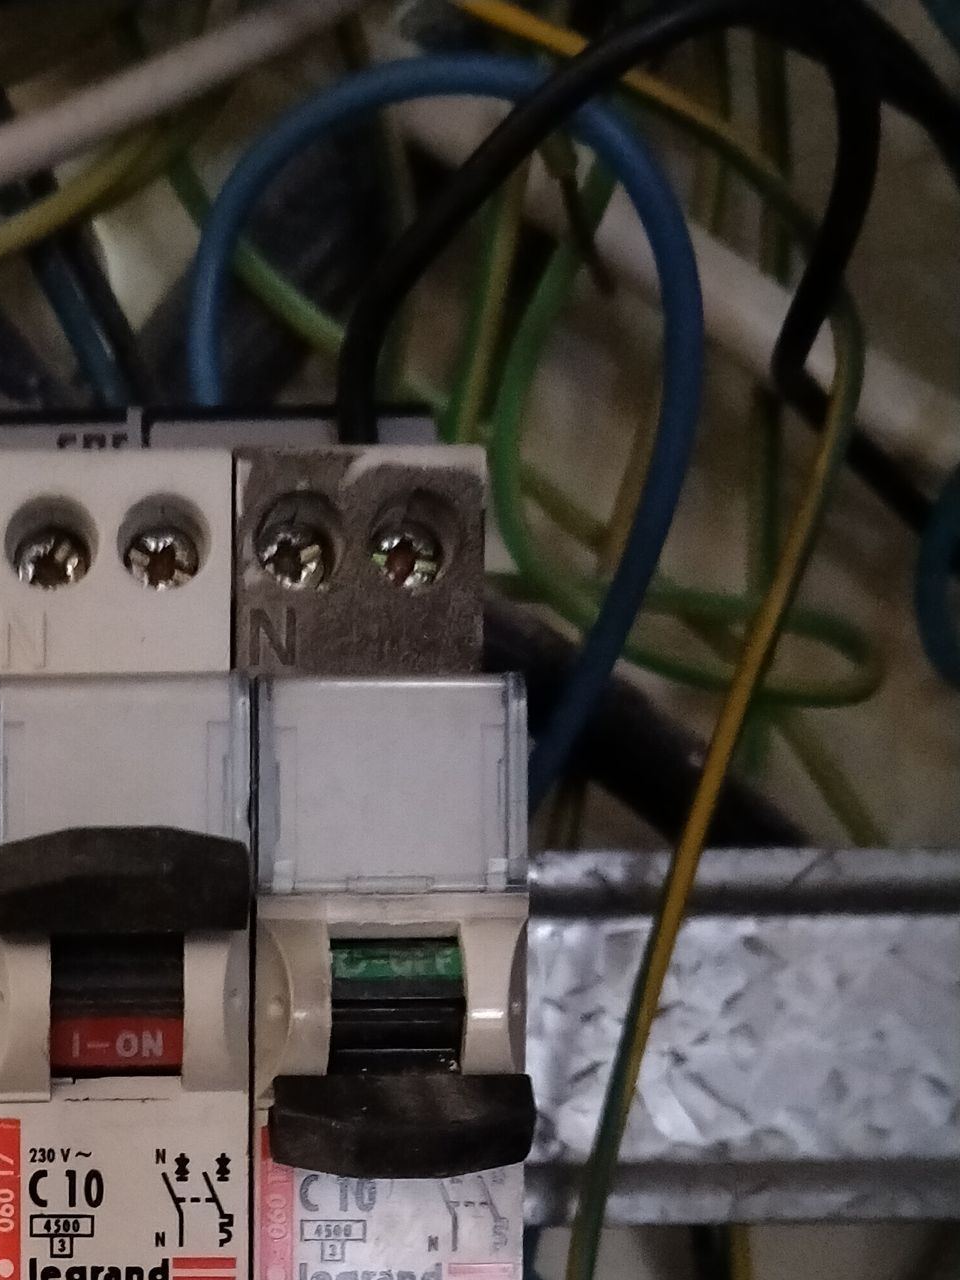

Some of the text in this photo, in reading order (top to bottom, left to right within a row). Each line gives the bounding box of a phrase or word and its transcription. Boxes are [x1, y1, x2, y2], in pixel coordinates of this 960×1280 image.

[249, 606, 297, 667] N
[29, 1147, 56, 1163] 230
[155, 1148, 166, 1164] N
[43, 1218, 81, 1233] 4500
[57, 1239, 67, 1253] 3
[155, 1231, 166, 1247] N
